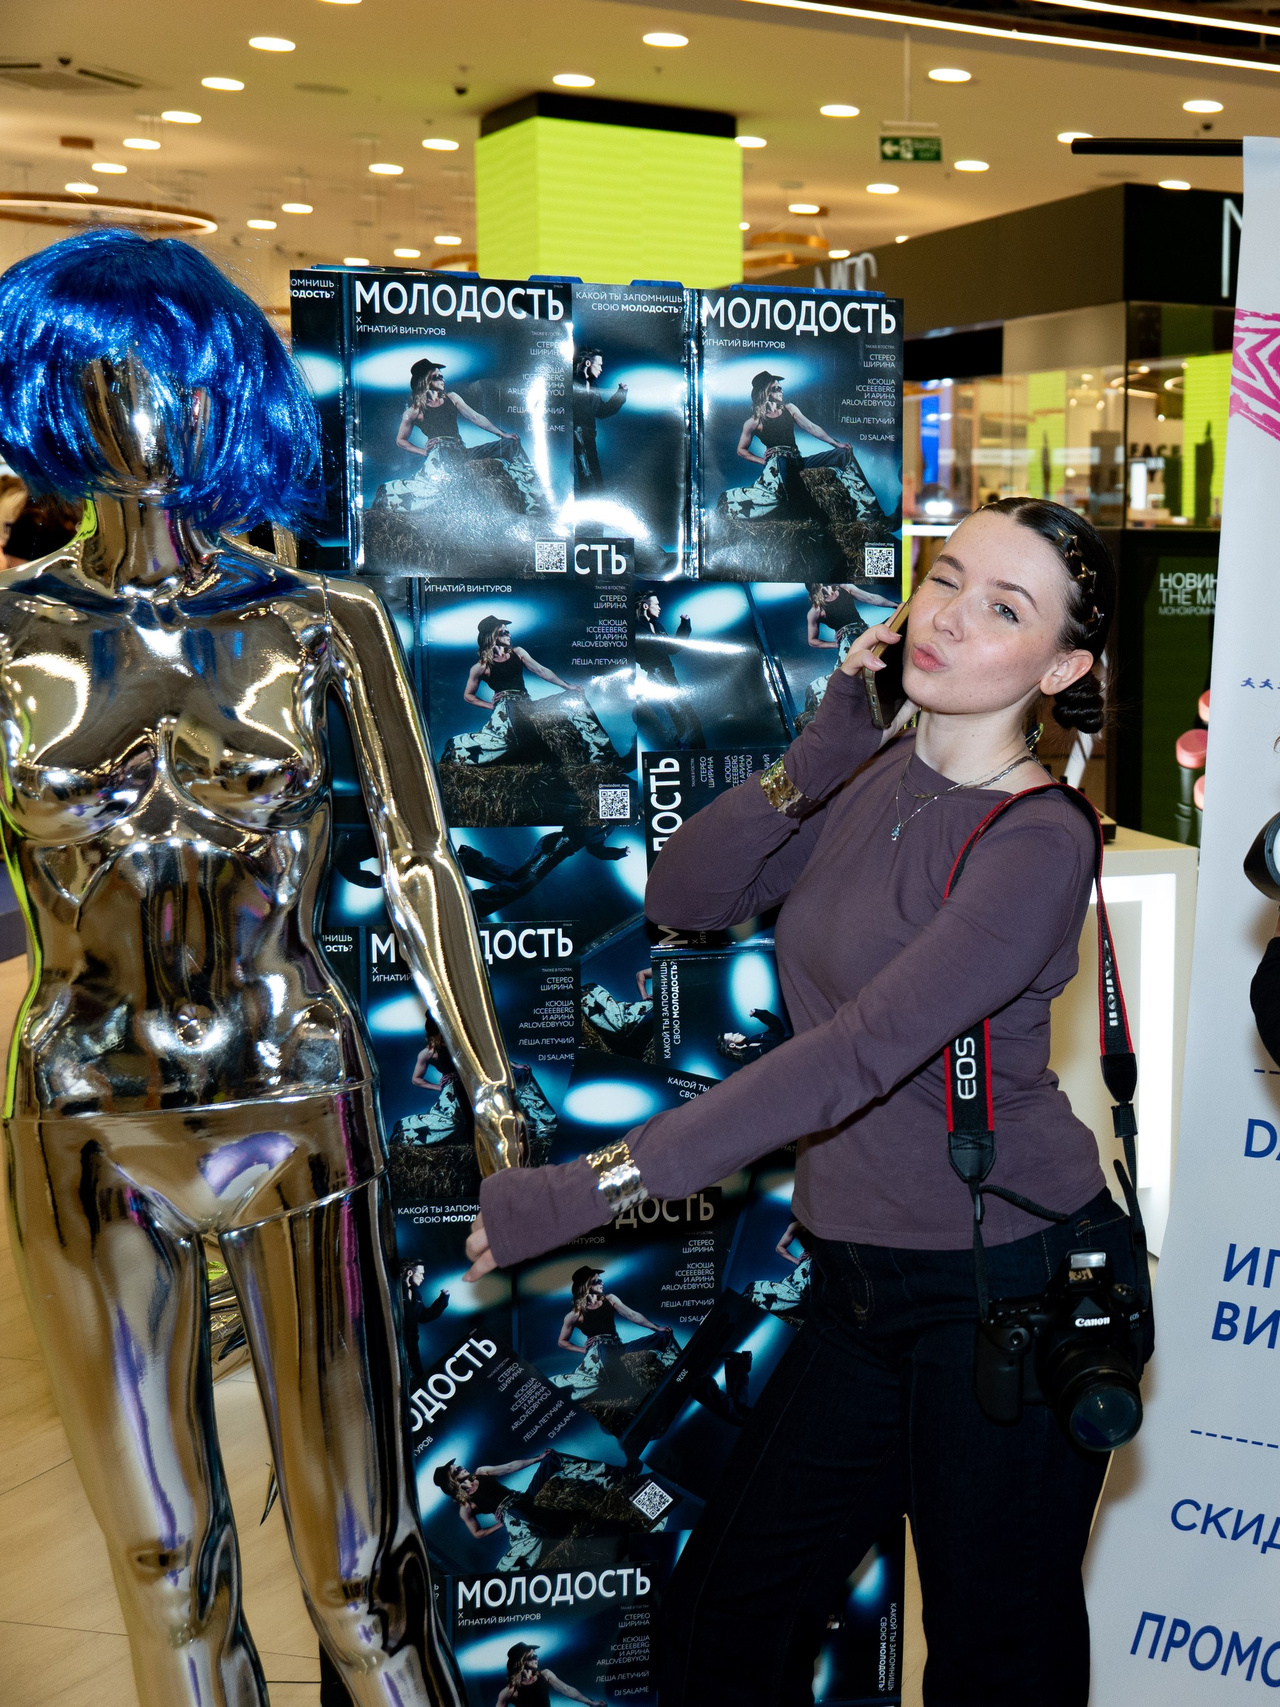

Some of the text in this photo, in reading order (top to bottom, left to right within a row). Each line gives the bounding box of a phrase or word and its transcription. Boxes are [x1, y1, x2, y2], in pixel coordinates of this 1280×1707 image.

[355, 280, 564, 323] МОЛОДОСТЬ
[576, 291, 607, 300] КАКОЙ
[622, 294, 682, 303] ЗАПОМНИШЬ
[592, 303, 683, 314] СВОЮ МОЛОДОСТЬ?
[702, 296, 896, 337] МОЛОДОСТЬ
[356, 324, 446, 336] ИГНАТИЙ ВИНТУРОВ
[702, 338, 785, 349] ИГНАТИЙ ВИНТУРОВ
[863, 360, 895, 368] ШИРИНА
[424, 584, 512, 593] ИГНАТИЙ ВИНТУРОВ
[600, 594, 627, 602] СТЕРЕО
[1159, 588, 1192, 605] THE
[371, 928, 573, 965] МДОСТЬ
[546, 976, 574, 984] СТЕРЕО
[670, 961, 681, 1045] СВОЮ МОЛОДОСТЬ?
[660, 961, 671, 1059] КАКОЙ ТЫ ЗАПОМНИШЬ
[956, 1036, 978, 1100] EOS
[668, 1076, 697, 1089] КАКОЙ
[397, 1205, 428, 1215] КАКОЙ
[430, 1205, 443, 1213] ТЫ
[603, 1193, 714, 1230] ДОСТЬ
[413, 1215, 441, 1225] СВОЮ
[1075, 1316, 1110, 1328] Canon
[458, 1568, 651, 1609] МОЛОДОСТЬ
[458, 1613, 541, 1627] ИГНАТИЙ ВИНТУРОВ
[880, 1617, 888, 1641] СВОЮ
[888, 1602, 898, 1691] КАКОЙ ТЫ ЗАПОМНИШЬ
